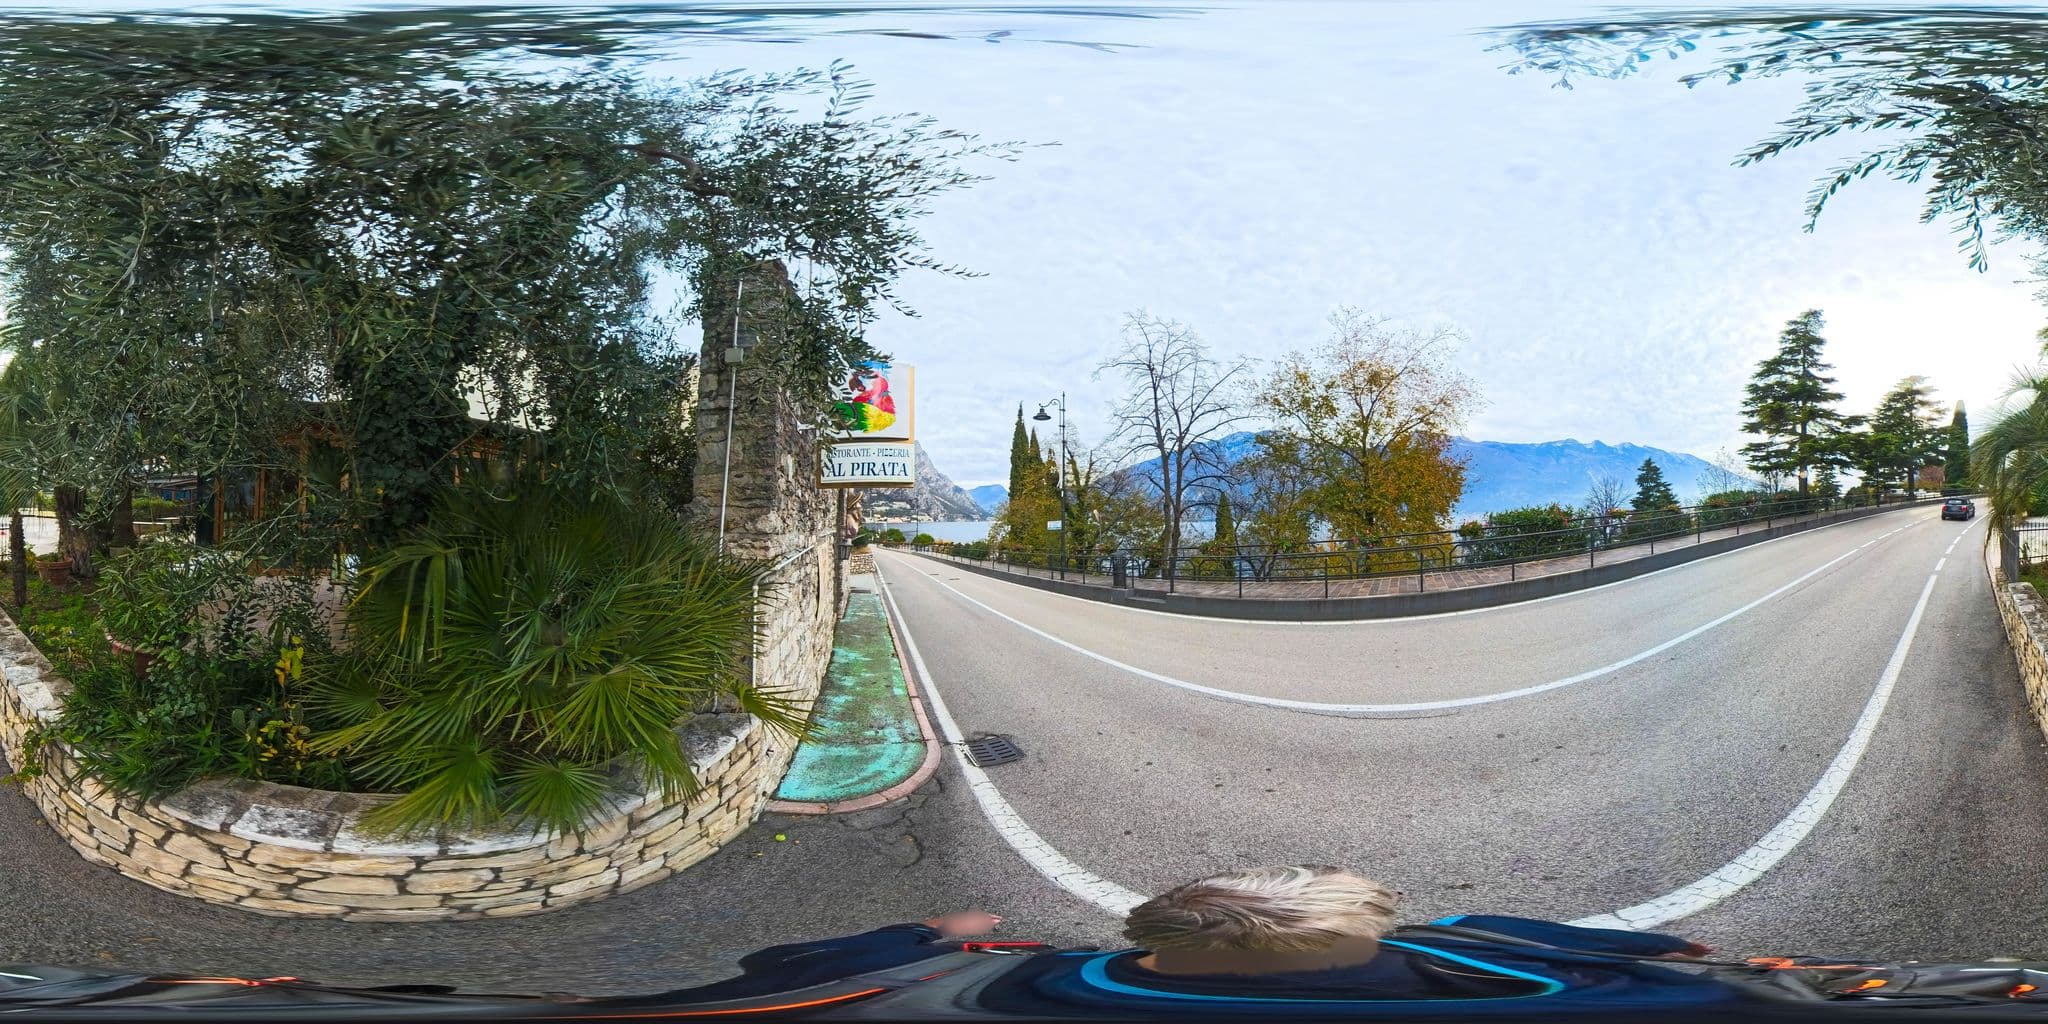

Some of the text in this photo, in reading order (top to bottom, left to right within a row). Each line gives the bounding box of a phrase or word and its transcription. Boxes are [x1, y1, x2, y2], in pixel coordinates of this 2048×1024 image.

[830, 448, 870, 458] STORANTE
[877, 448, 910, 457] PIZZERIA
[827, 462, 908, 477] AL PIRATA
